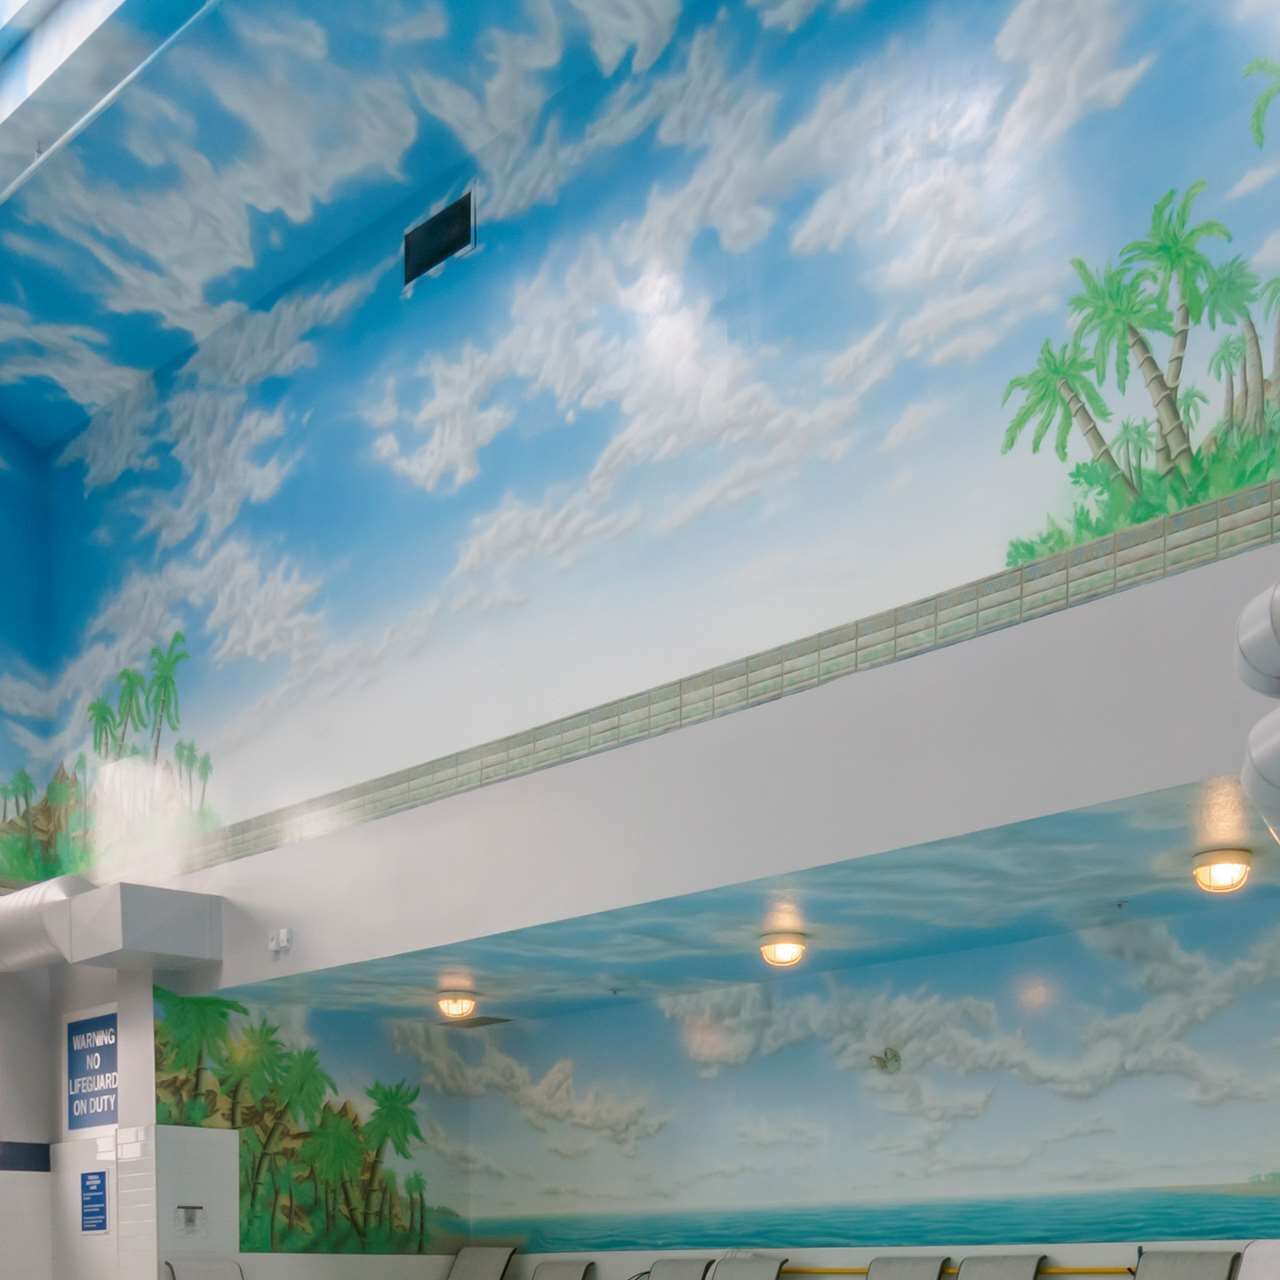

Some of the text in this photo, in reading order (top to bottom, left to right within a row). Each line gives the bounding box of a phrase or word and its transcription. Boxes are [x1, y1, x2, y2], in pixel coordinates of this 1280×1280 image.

[73, 1028, 115, 1051] WARNING
[86, 1053, 101, 1070] NO
[70, 1071, 118, 1095] LIFEGUARD
[73, 1095, 116, 1116] ON DUTY
